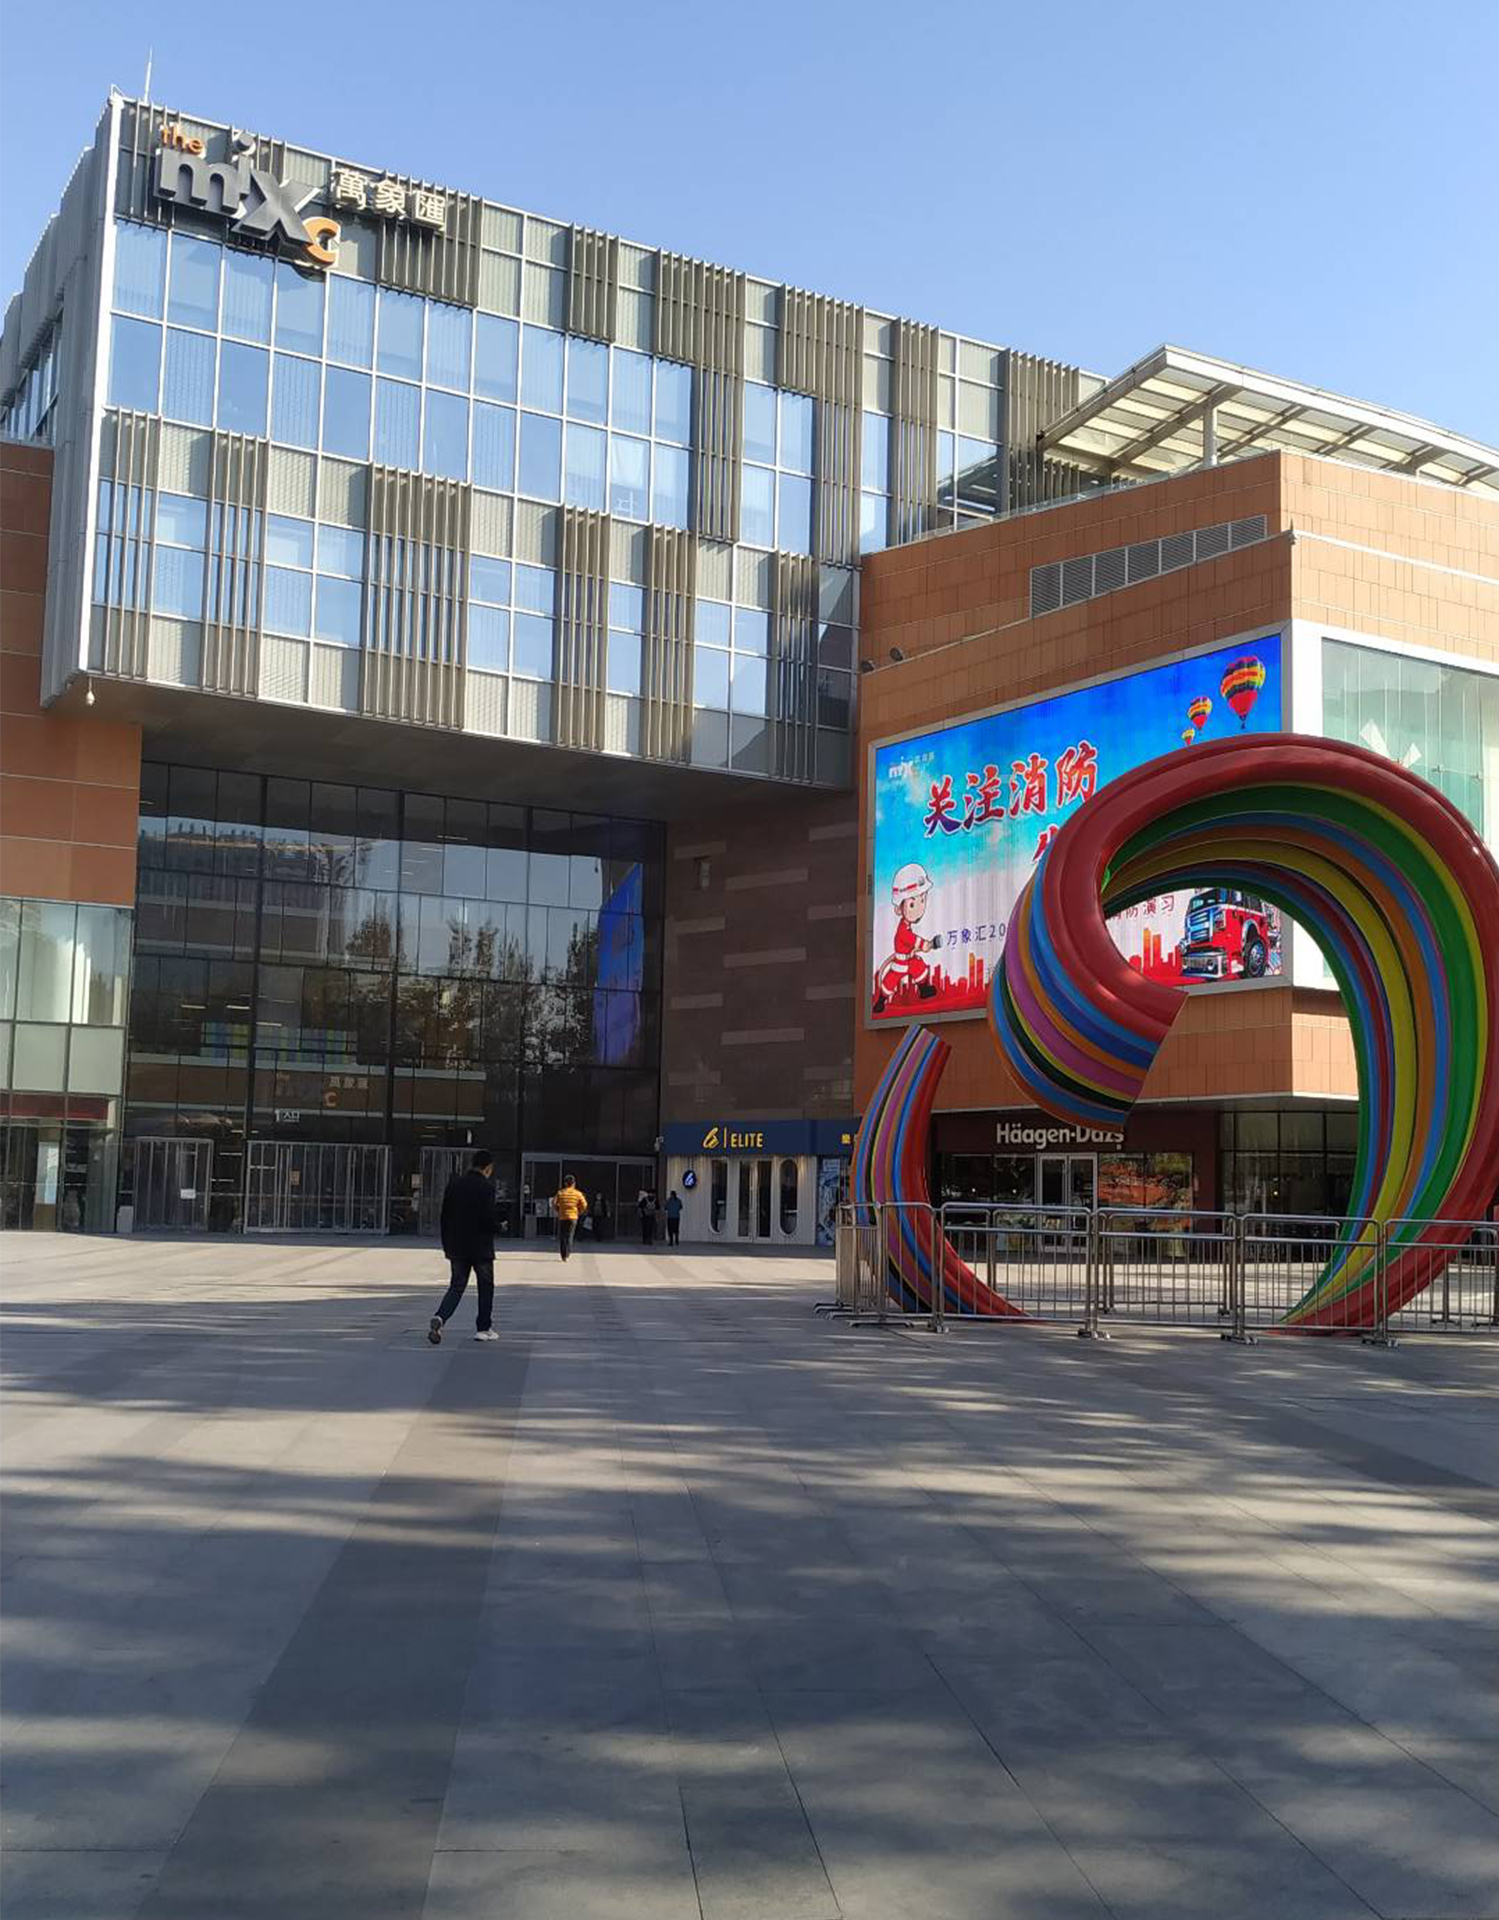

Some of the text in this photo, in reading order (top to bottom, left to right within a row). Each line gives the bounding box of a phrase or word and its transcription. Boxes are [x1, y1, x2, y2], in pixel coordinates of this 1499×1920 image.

[161, 124, 205, 156] the
[335, 169, 446, 230] 萬象匯
[923, 740, 1098, 838] 关注消防
[730, 1132, 764, 1148] ELITE
